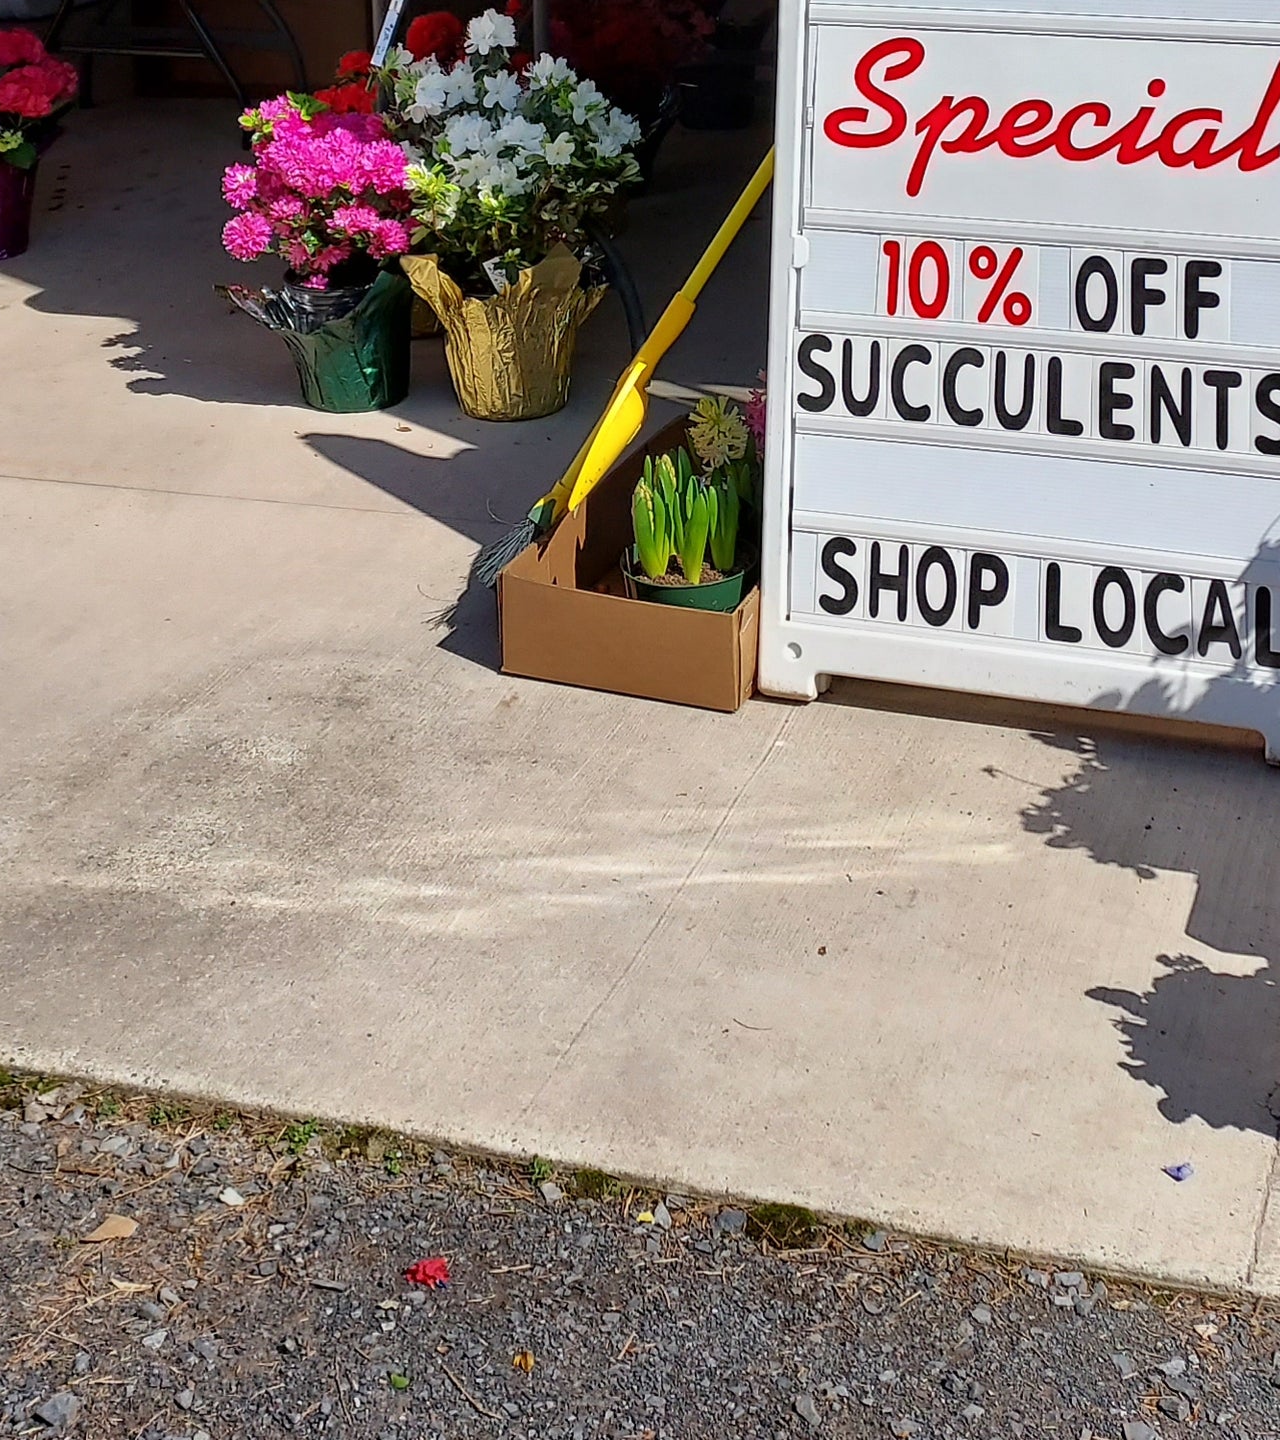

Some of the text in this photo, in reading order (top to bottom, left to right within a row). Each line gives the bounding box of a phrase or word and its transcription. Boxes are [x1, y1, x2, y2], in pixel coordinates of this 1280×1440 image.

[879, 239, 1223, 340] 10% OFF
[818, 536, 1010, 630] SHOP
